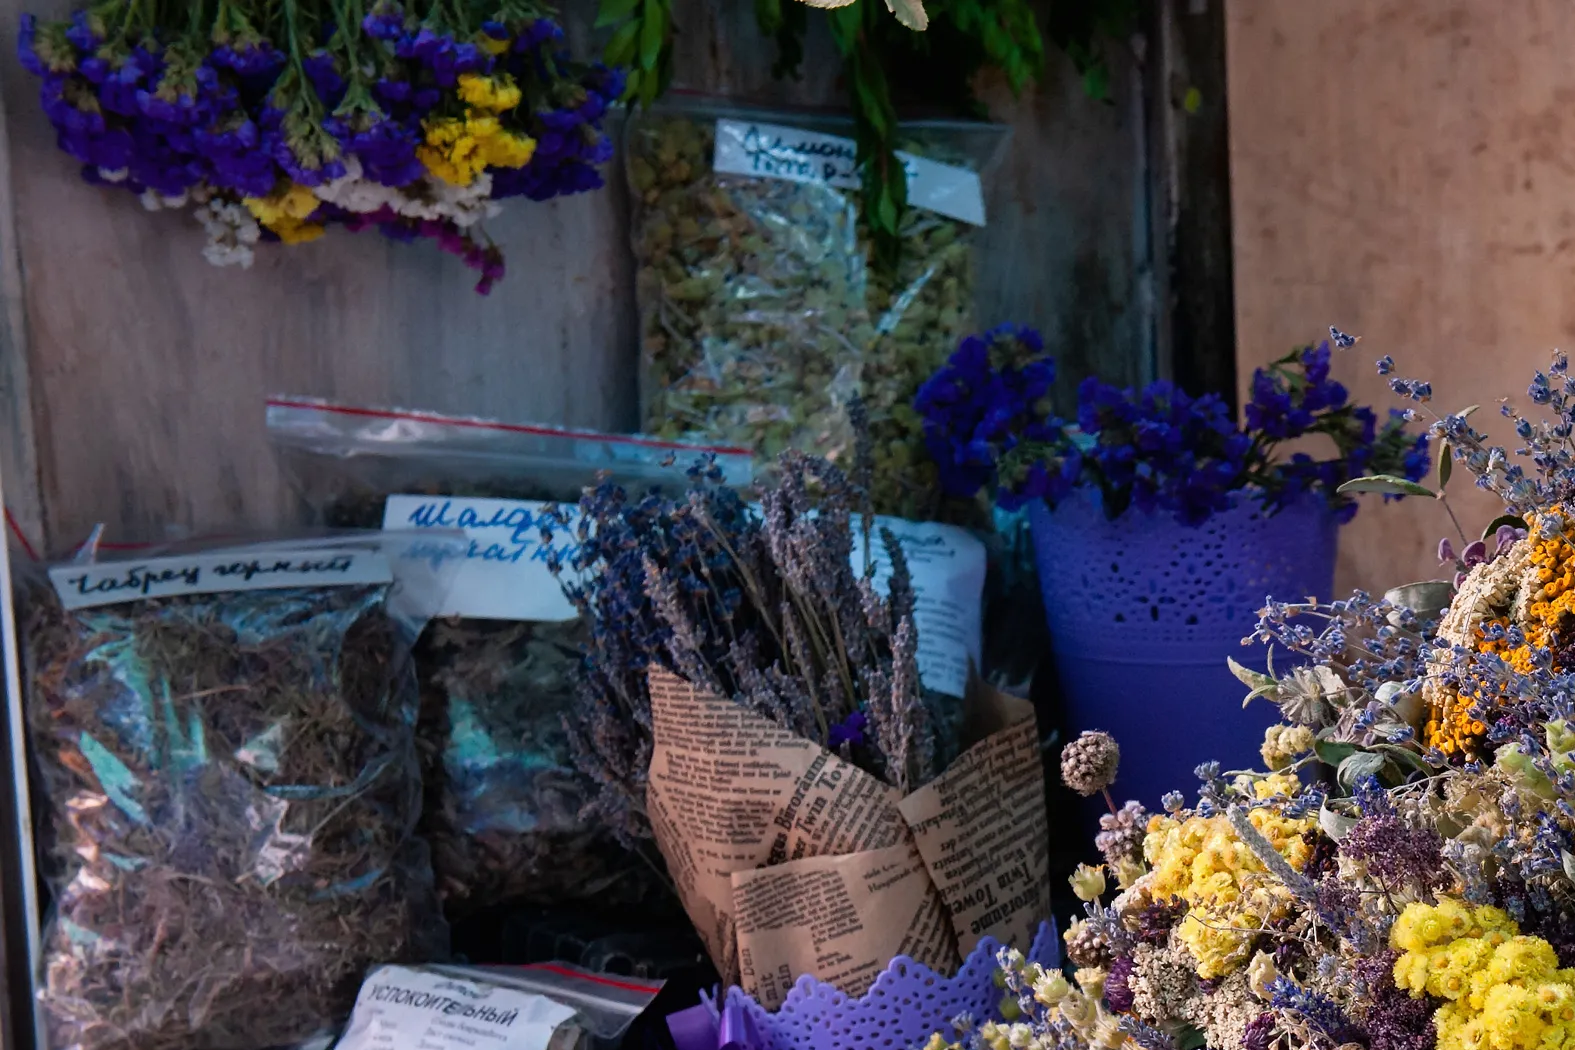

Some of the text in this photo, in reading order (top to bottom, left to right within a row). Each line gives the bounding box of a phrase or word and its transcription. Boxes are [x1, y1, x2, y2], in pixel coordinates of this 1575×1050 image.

[68, 555, 354, 594] Чабрец горный
[794, 794, 828, 835] Twin
